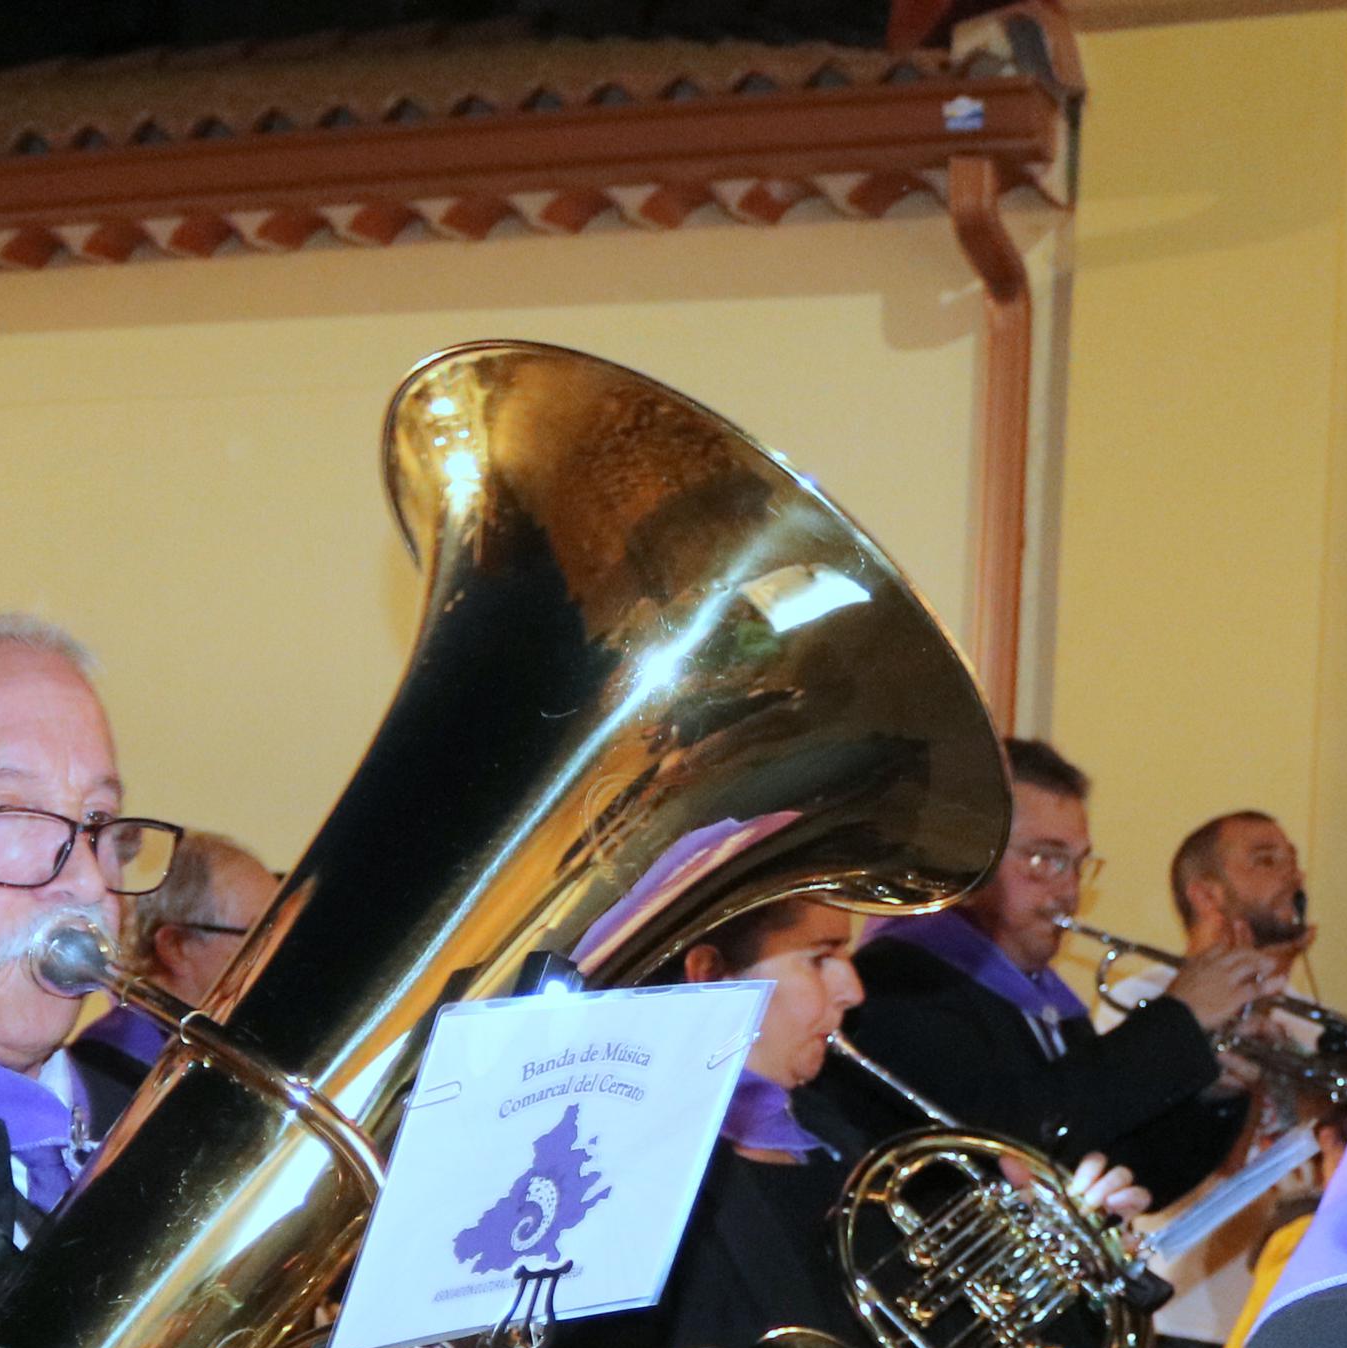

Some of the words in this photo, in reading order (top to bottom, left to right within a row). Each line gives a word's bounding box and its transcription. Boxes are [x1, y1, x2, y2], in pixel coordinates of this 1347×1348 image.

[522, 1048, 576, 1082] Banda
[579, 1043, 599, 1063] de
[601, 1042, 651, 1066] Música
[498, 1075, 574, 1119] Comarcal
[574, 1073, 599, 1093] del
[599, 1074, 645, 1101] Cerrato
